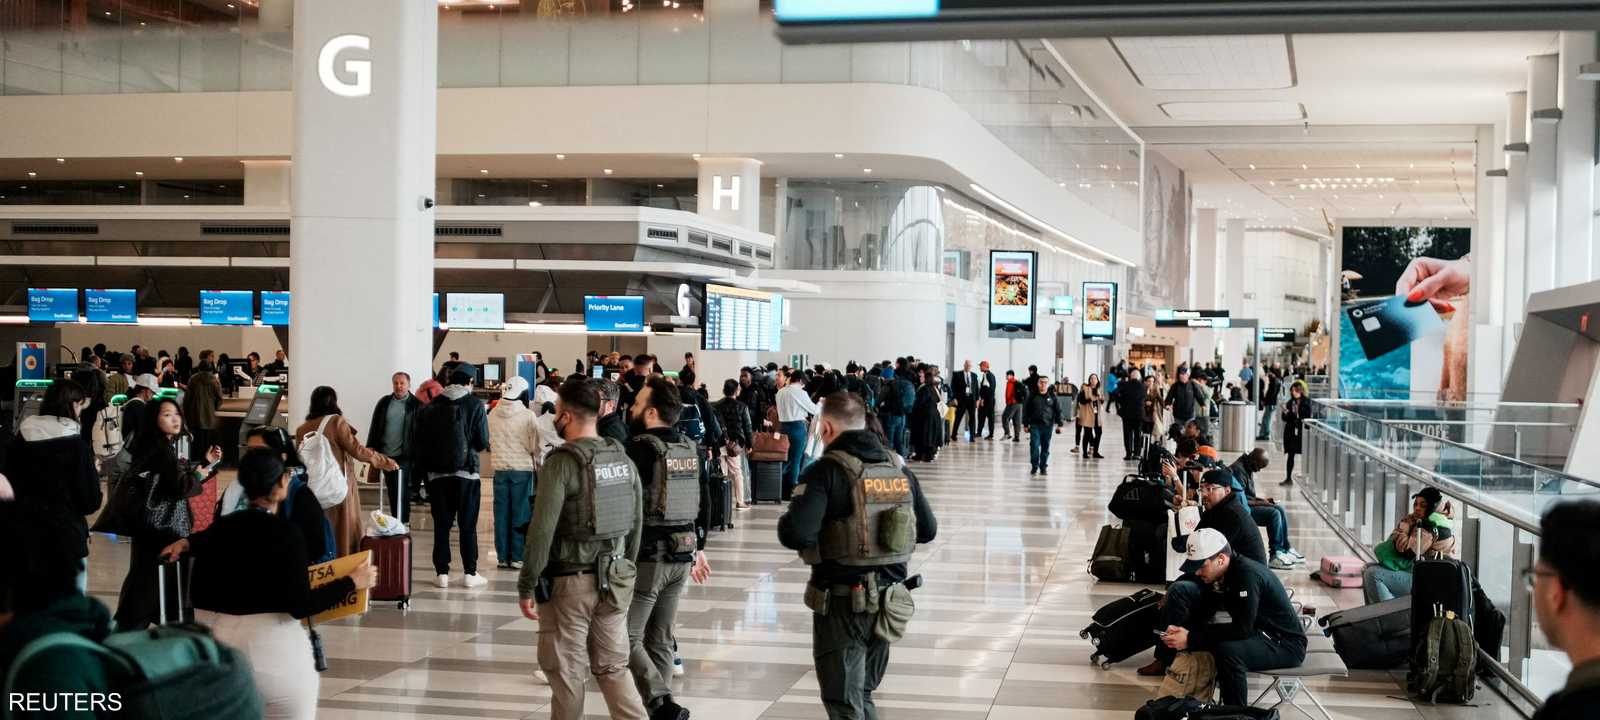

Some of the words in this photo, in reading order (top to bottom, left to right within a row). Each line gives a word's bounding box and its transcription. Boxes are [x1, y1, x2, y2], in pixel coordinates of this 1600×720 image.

[317, 34, 372, 97] G
[712, 175, 741, 211] H
[588, 304, 609, 312] Priority
[595, 464, 630, 480] POLICE
[666, 458, 697, 471] POLICE
[863, 479, 909, 493] POLICE
[308, 565, 334, 582] TSA
